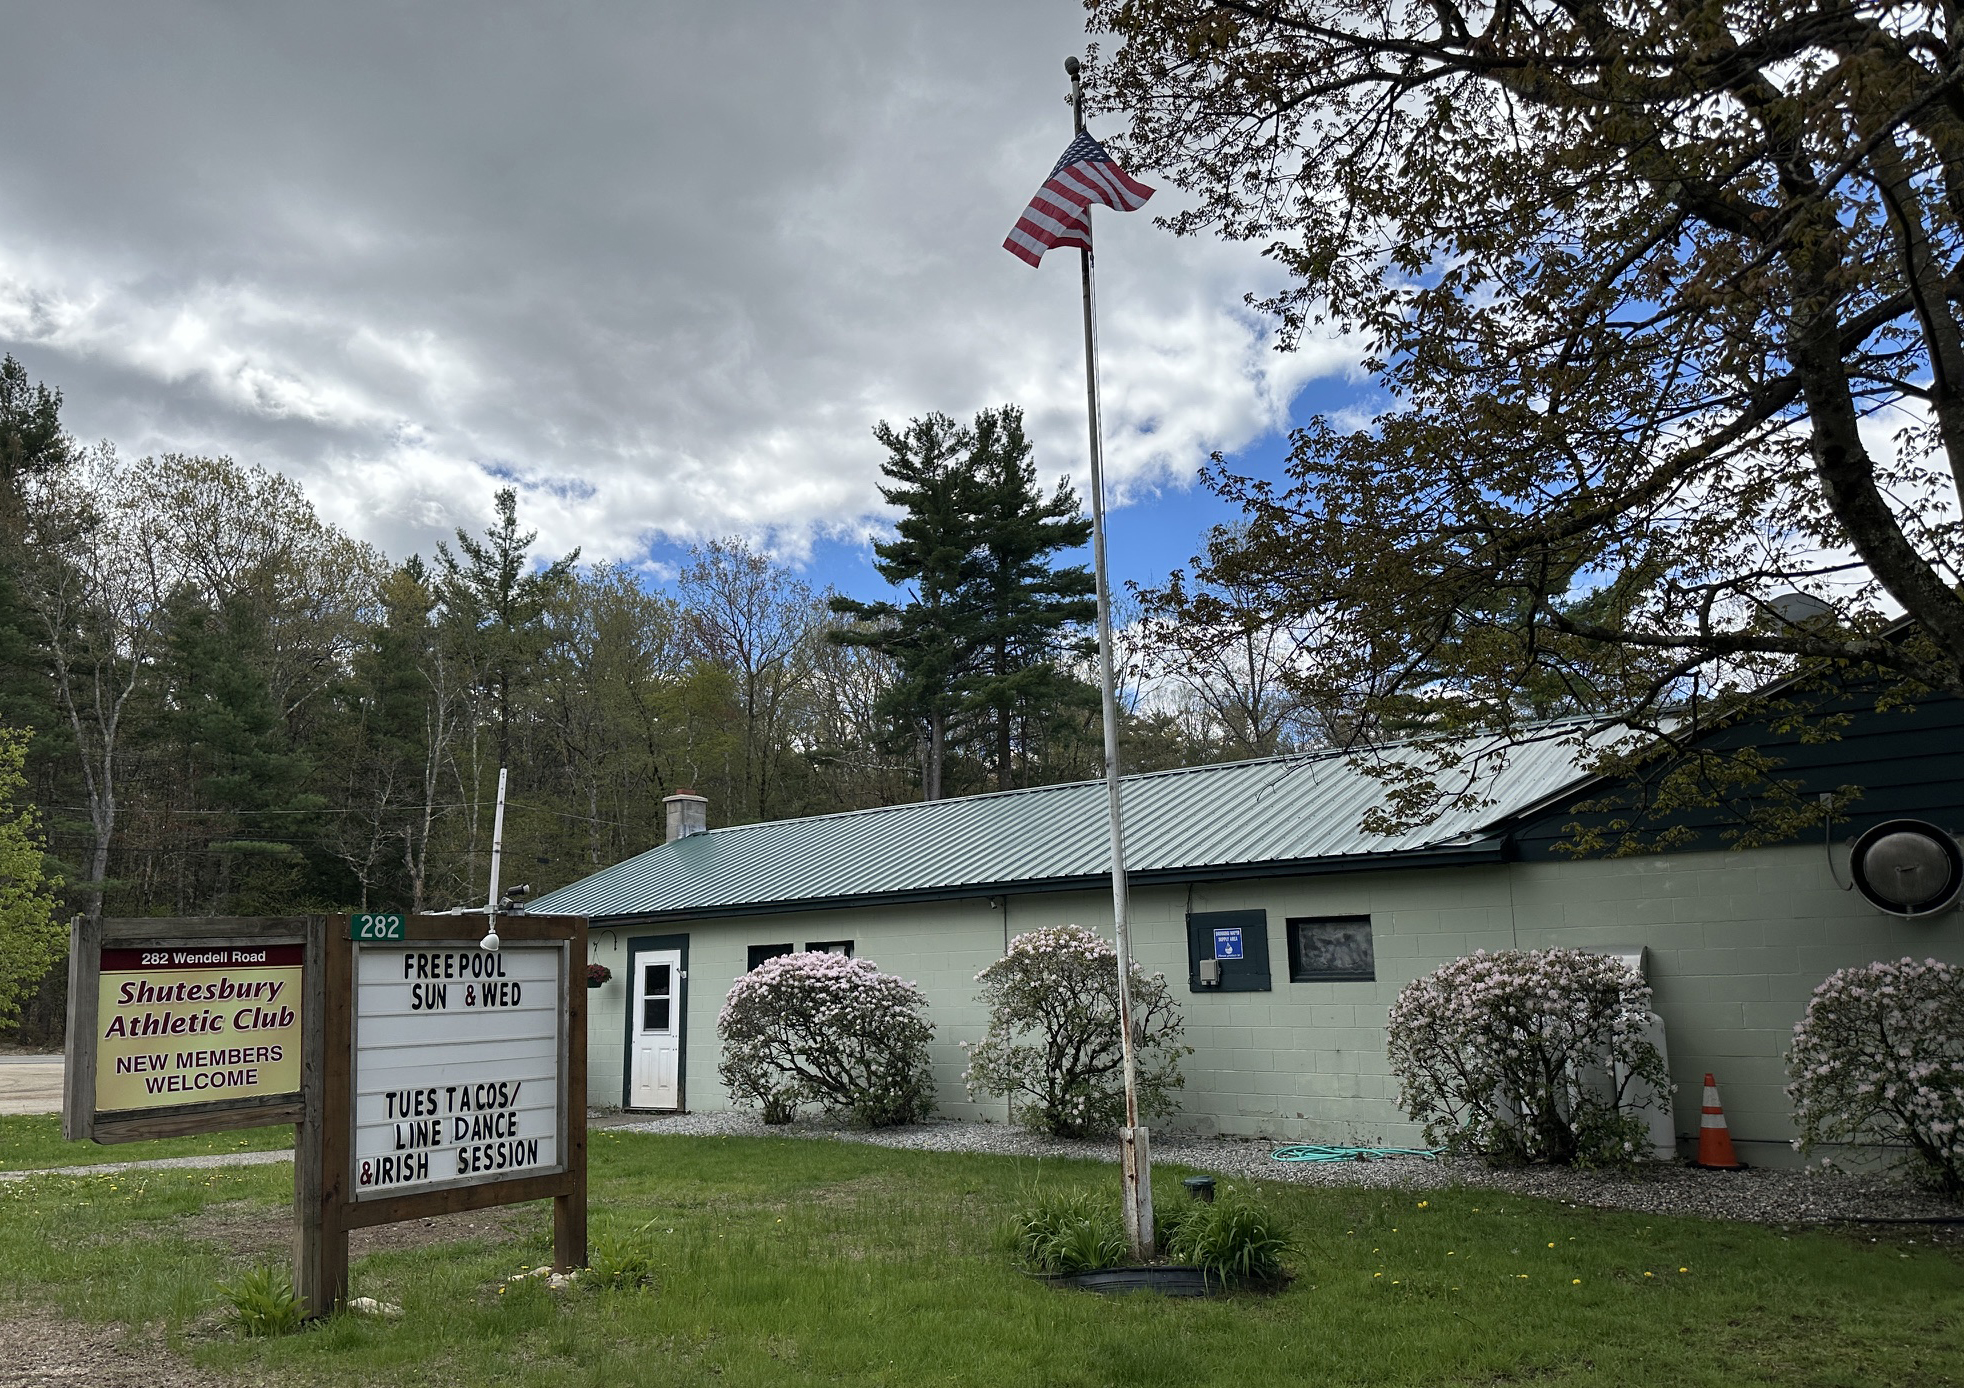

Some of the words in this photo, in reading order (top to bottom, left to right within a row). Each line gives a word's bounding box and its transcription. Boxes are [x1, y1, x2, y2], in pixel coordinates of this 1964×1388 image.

[361, 916, 399, 938] 282
[142, 953, 168, 964] 282
[174, 952, 227, 963] Wendell
[232, 951, 266, 962] Road
[118, 978, 284, 1004] Shutesbury
[412, 984, 446, 1009] SUN
[465, 985, 475, 1006] &
[482, 982, 521, 1007] WED
[105, 1010, 223, 1038] Athletic
[233, 1006, 295, 1030] Club
[116, 1054, 169, 1074] NEW
[177, 1046, 283, 1068] MEMBERS
[145, 1069, 258, 1094] WELCOME
[386, 1088, 437, 1119] TUES
[396, 1120, 441, 1150] LINE
[455, 1112, 517, 1141] DANCE
[458, 1139, 537, 1174] SESSION
